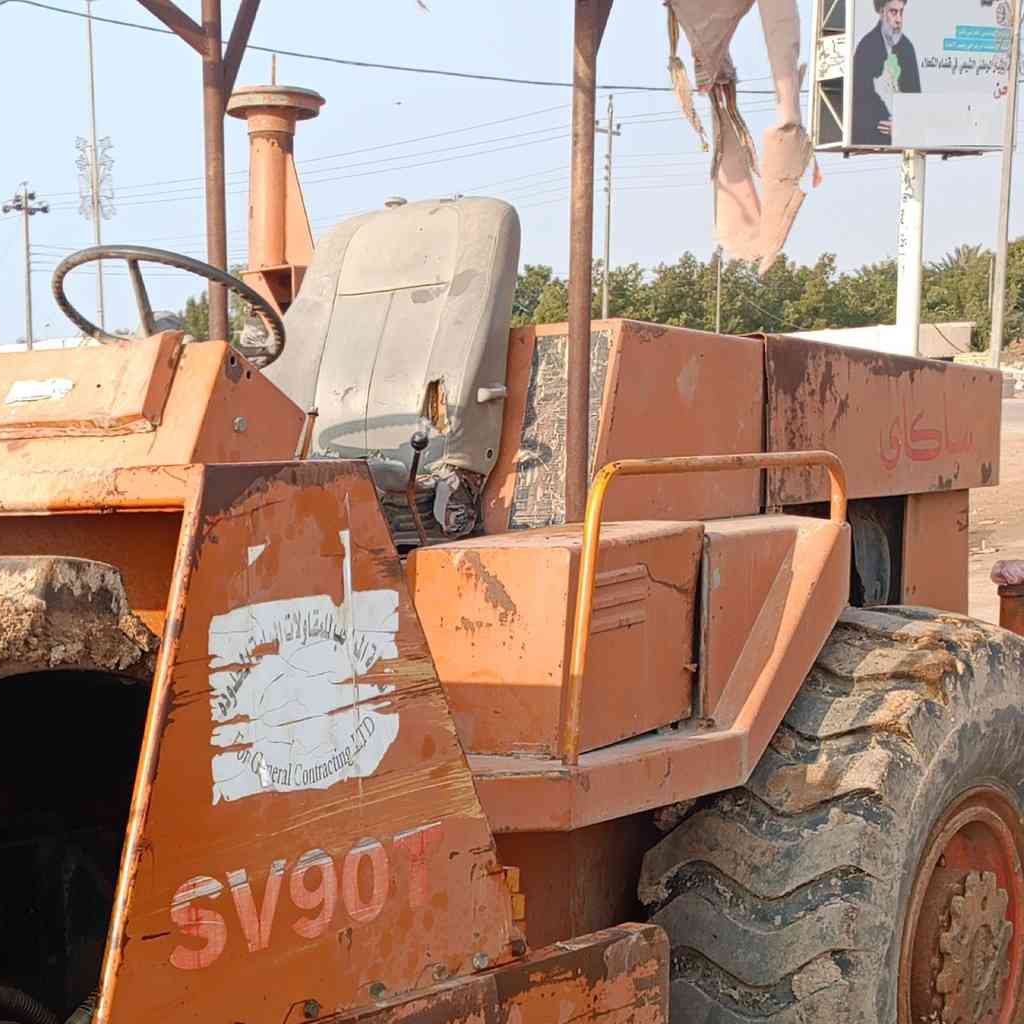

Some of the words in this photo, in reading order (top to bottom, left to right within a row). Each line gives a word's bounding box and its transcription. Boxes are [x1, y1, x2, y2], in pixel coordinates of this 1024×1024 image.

[249, 751, 293, 787] Gneral
[294, 745, 355, 787] Contracting
[350, 715, 376, 752] LTD
[169, 821, 442, 970] SV90T
